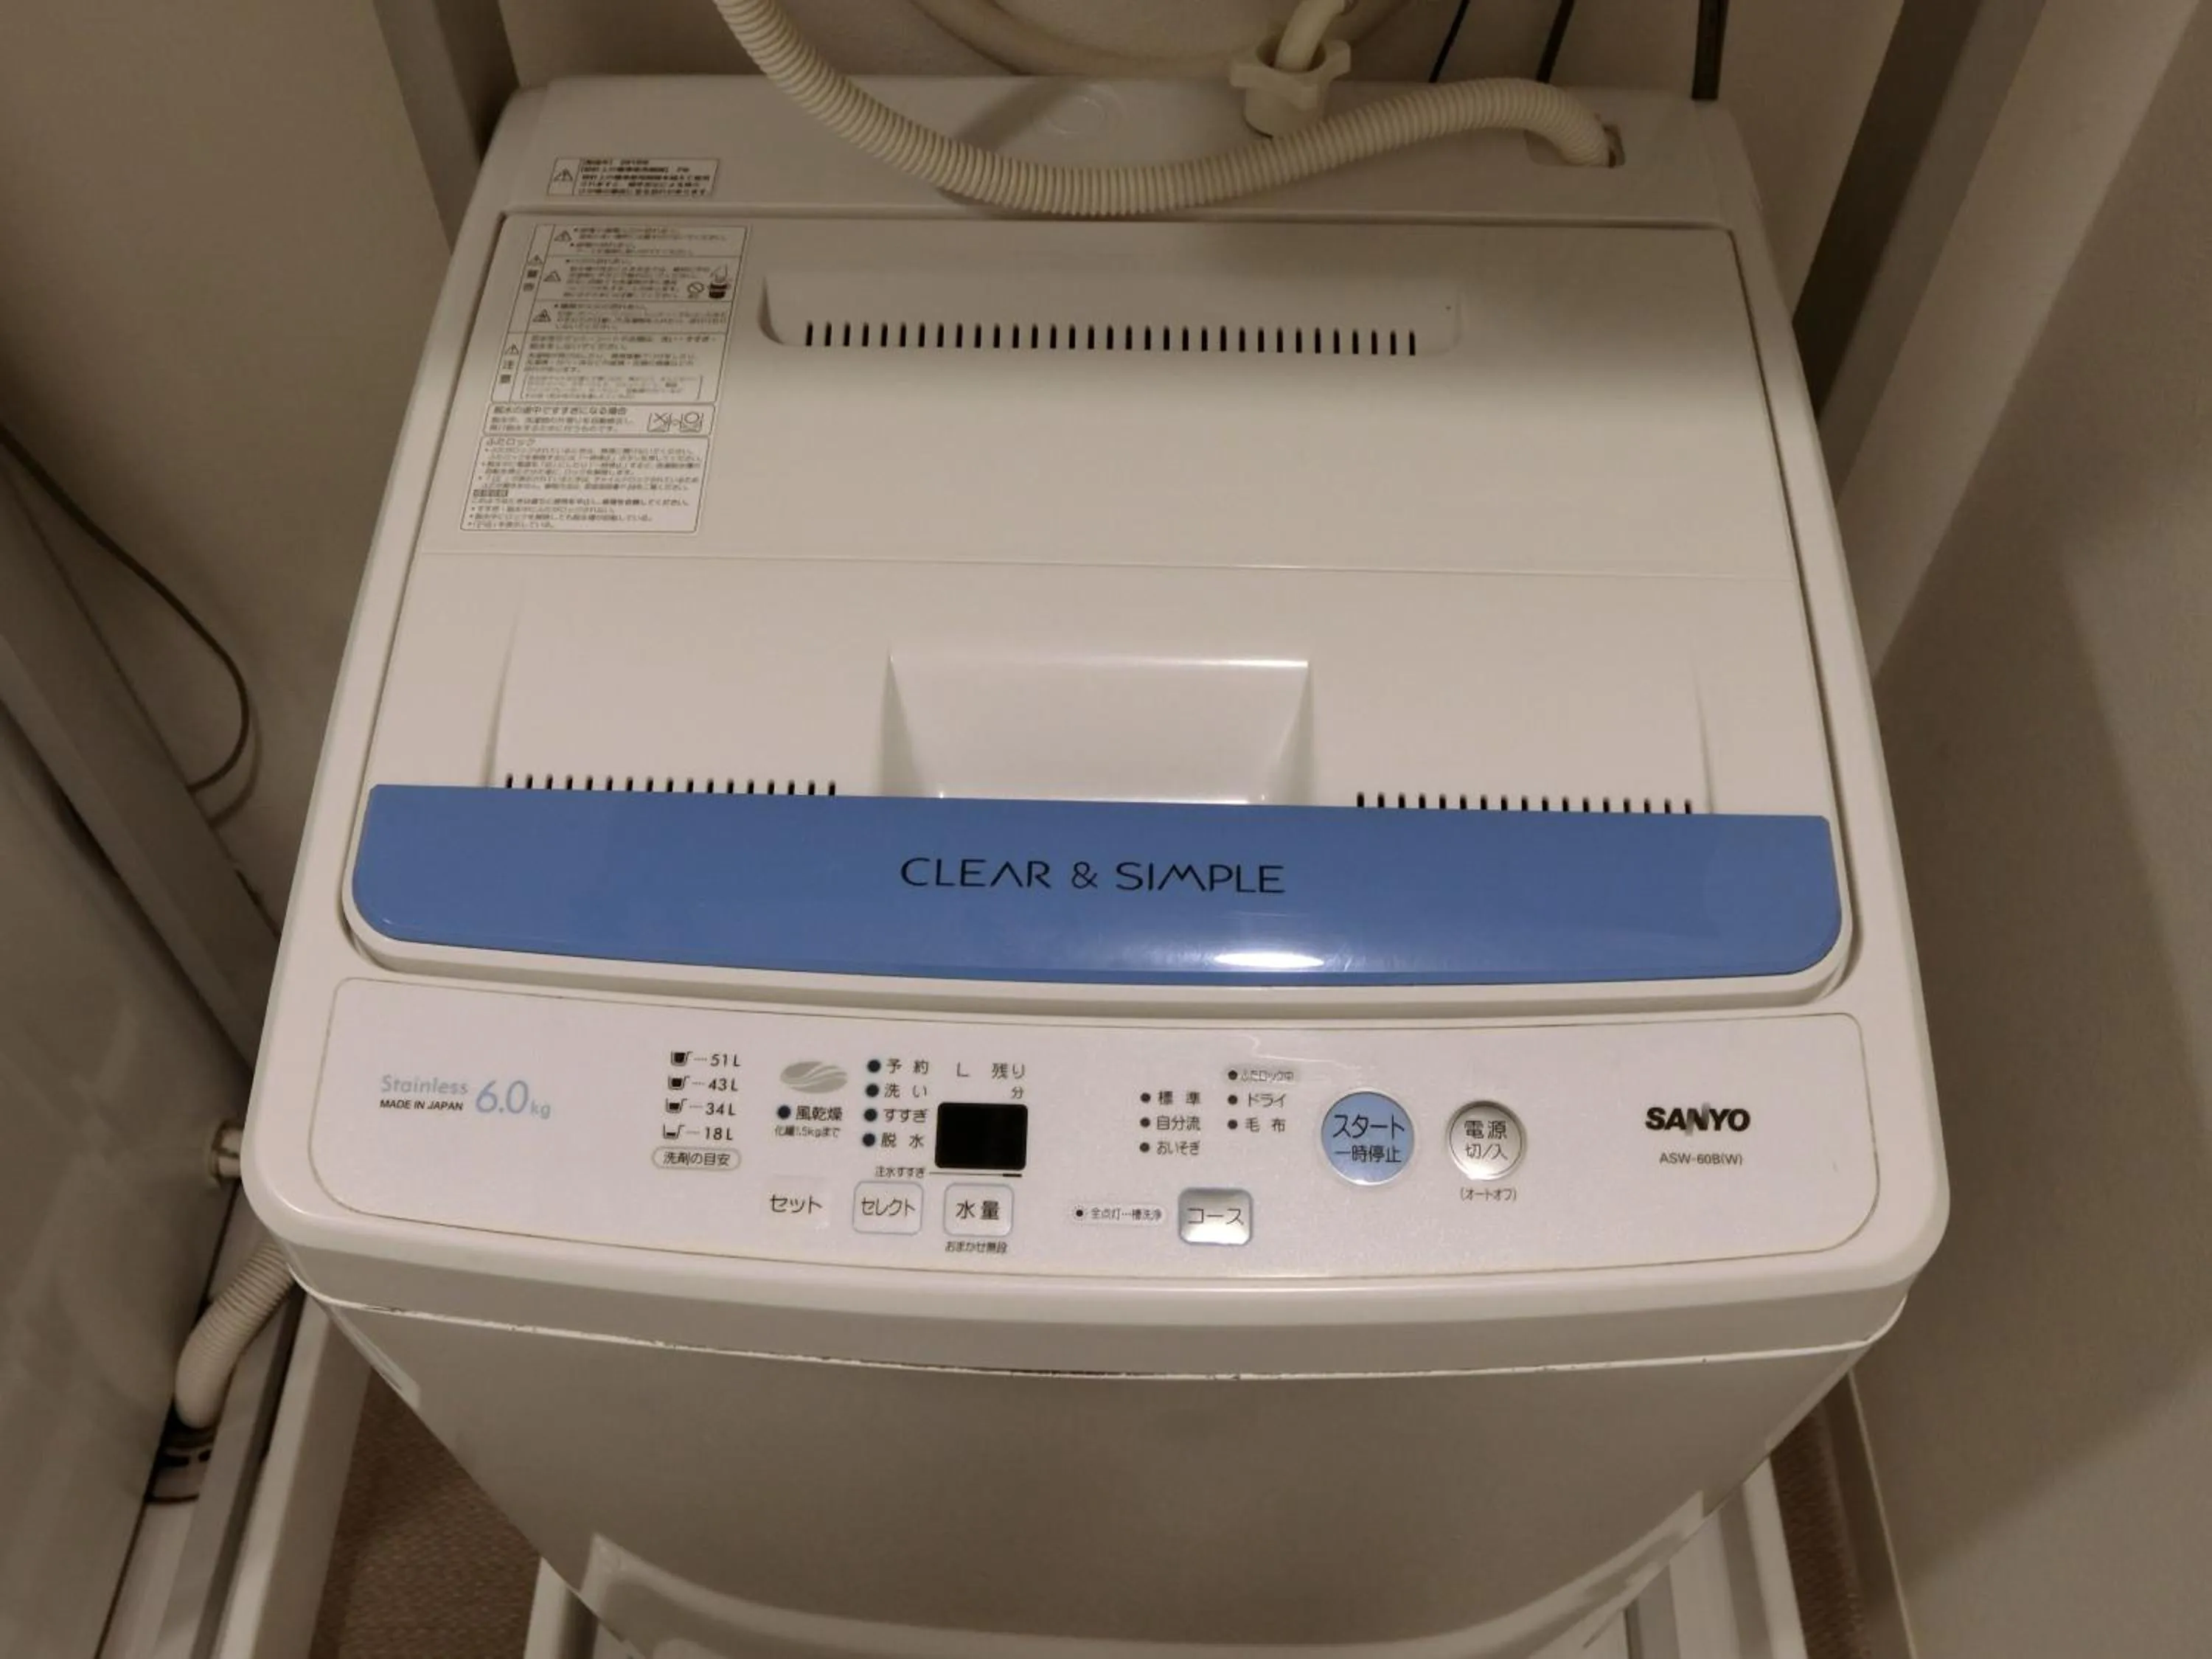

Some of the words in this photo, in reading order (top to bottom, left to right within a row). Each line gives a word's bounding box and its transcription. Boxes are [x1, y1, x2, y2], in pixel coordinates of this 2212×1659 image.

[900, 858, 1051, 888] CLEAR
[1071, 861, 1098, 889] &
[1116, 862, 1286, 893] SIMPLE
[991, 1062, 1026, 1079] 残り
[380, 1074, 469, 1094] Stainless
[1011, 1087, 1023, 1099] 分
[1248, 1093, 1286, 1107] ドライ
[380, 1099, 410, 1109] MADE
[414, 1100, 425, 1109] IN
[427, 1101, 463, 1111] JAPAN
[796, 1105, 842, 1121] 風乾燥
[884, 1108, 928, 1123] すすぎ
[1157, 1116, 1200, 1131] 自分流
[1645, 1102, 1751, 1136] SANYO
[1333, 1115, 1405, 1140] スタート
[1464, 1120, 1507, 1140] 電源
[1157, 1141, 1200, 1155] おいそぎ
[1335, 1144, 1401, 1163] 一時停止
[664, 1152, 731, 1166] 洗剤の目安
[1660, 1152, 1742, 1165] ASW-60B(W)
[770, 1194, 822, 1214] セット
[861, 1197, 916, 1216] セレクト
[1187, 1208, 1244, 1225] コース
